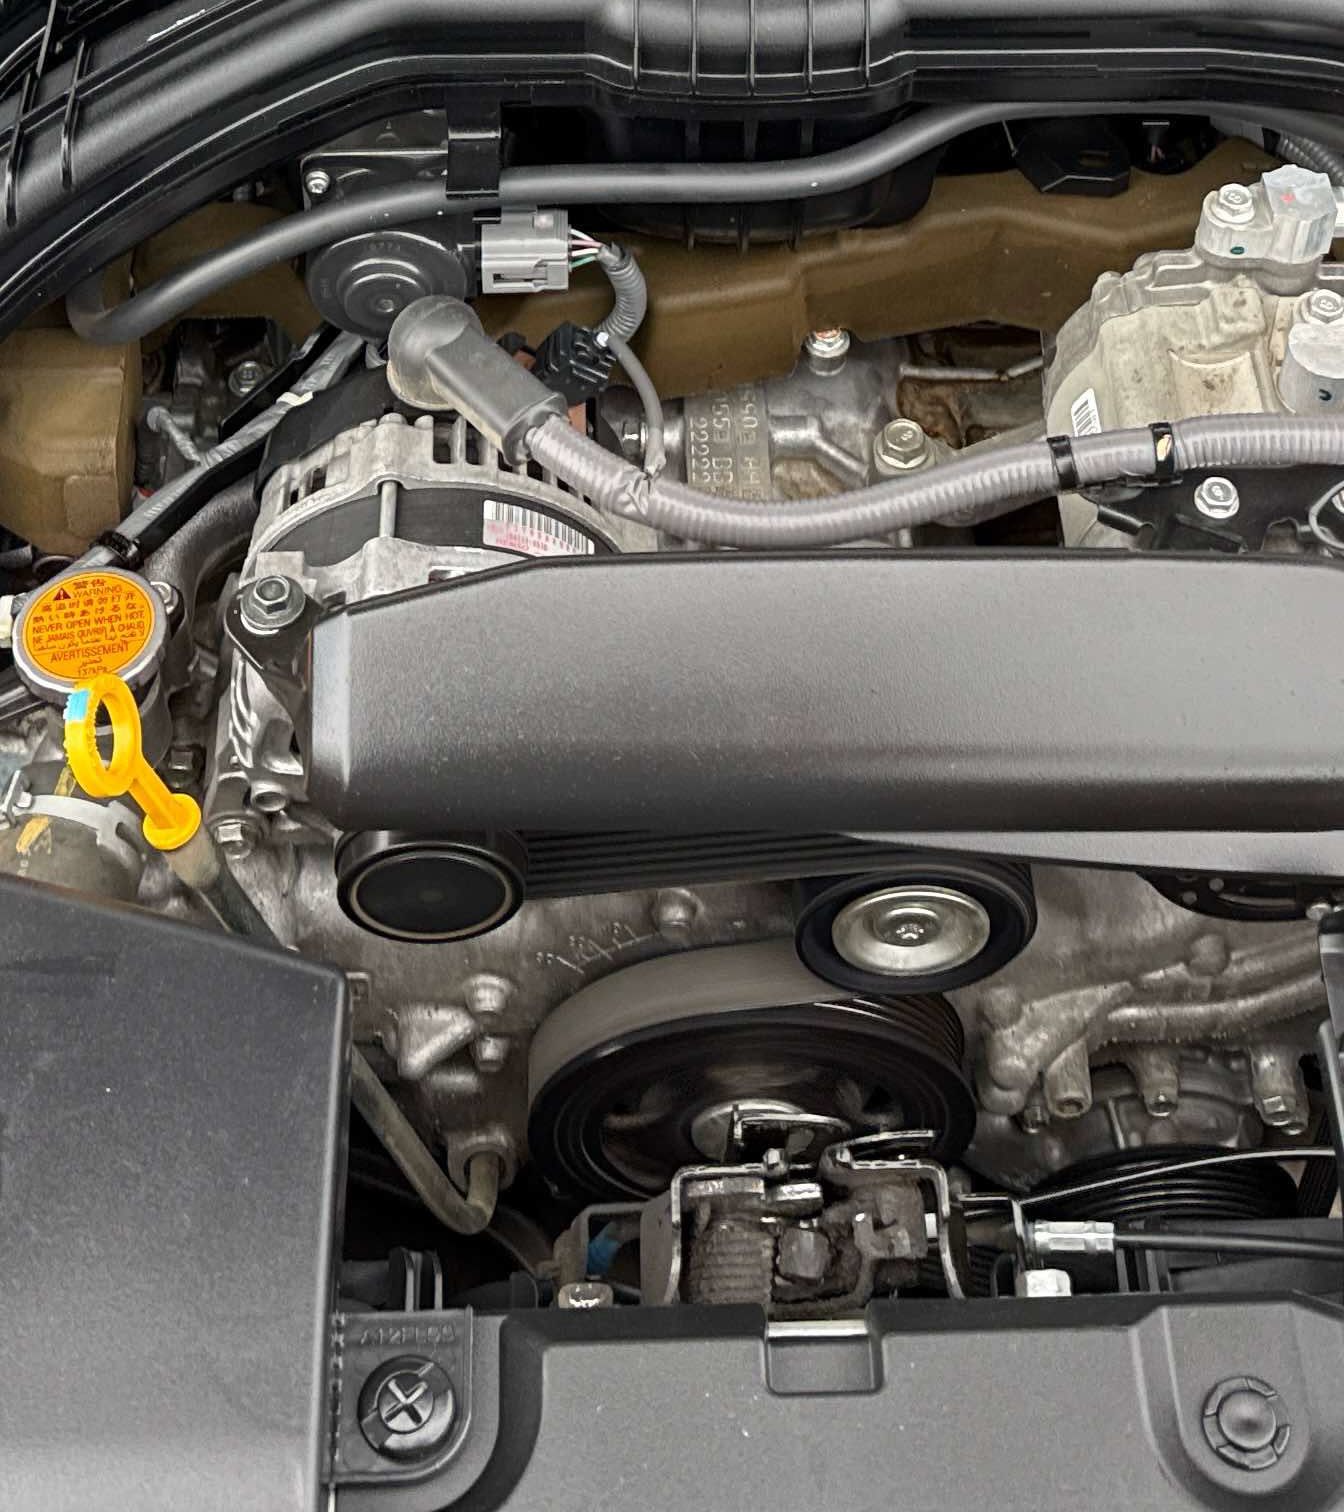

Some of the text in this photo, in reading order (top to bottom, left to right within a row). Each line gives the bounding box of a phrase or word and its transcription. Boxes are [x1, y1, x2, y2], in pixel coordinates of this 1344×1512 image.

[74, 584, 122, 598] WARNING
[33, 623, 62, 633] NEVER
[66, 619, 90, 629] OPEN
[94, 615, 121, 624] WHEN
[33, 637, 43, 645] NE
[48, 632, 75, 642] JAMAIS
[50, 640, 128, 663] AVERTISSEMENT
